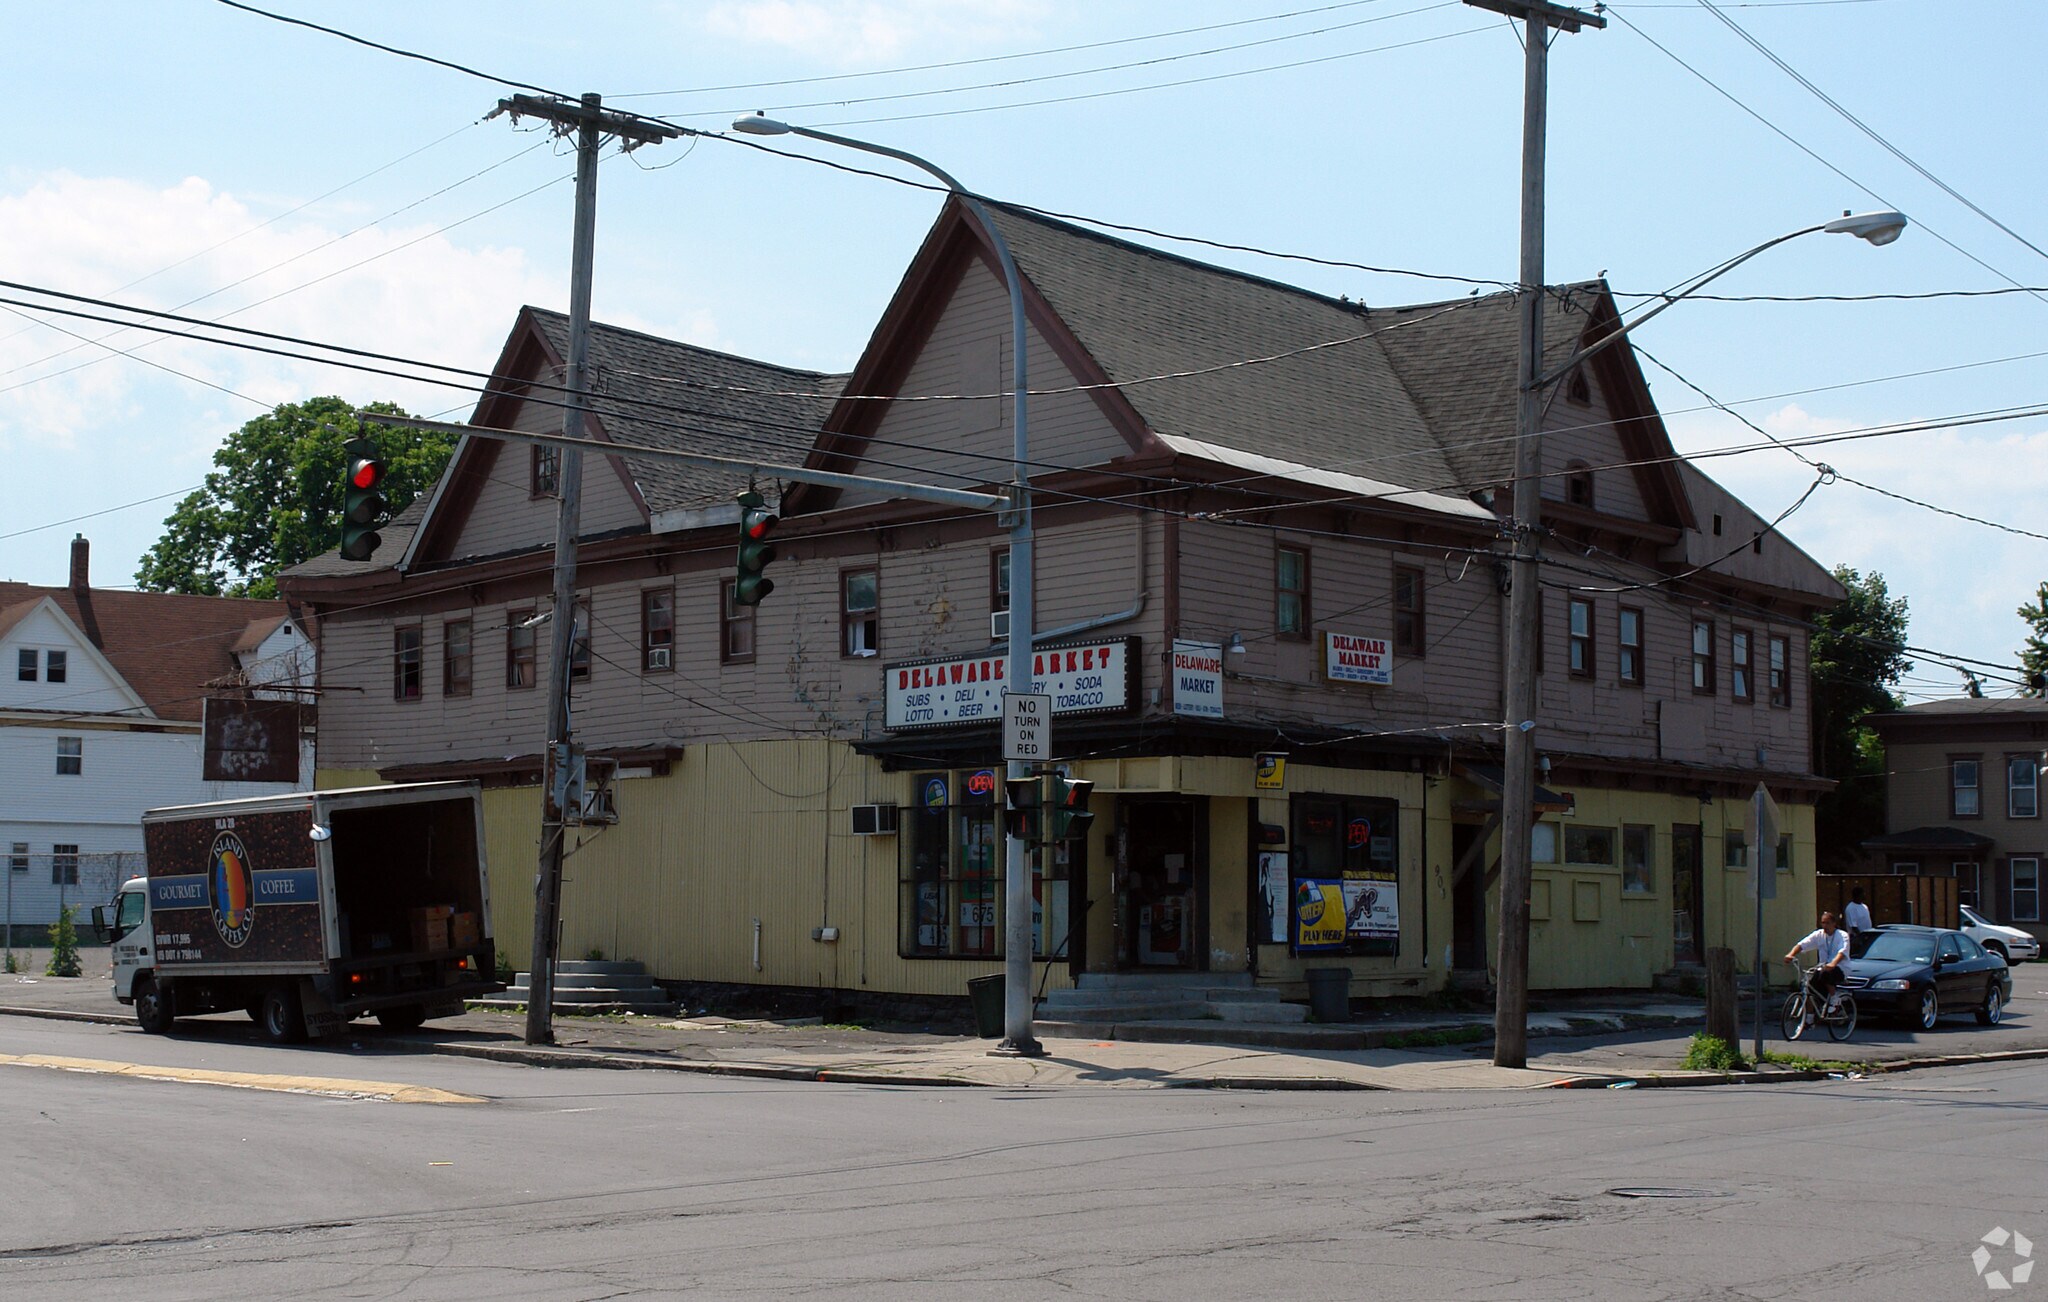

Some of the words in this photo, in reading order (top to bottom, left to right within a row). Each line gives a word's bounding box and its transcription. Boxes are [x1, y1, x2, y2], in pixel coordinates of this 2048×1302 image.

[1333, 636, 1386, 654] DELAWARE
[899, 660, 1004, 690] DELAWARE
[1034, 648, 1110, 676] ARKET
[1175, 654, 1220, 674] DELAWARE
[1339, 652, 1380, 670] MARKET
[906, 694, 930, 707] SUBS
[955, 688, 975, 702] DELI
[1075, 676, 1102, 690] SODA
[1180, 677, 1215, 694] MARKET
[905, 708, 934, 722] LOTTO
[958, 703, 983, 717] BEER
[1056, 692, 1104, 708] TOBACCO
[1019, 701, 1036, 713] NO
[1014, 716, 1040, 727] TURN
[1020, 730, 1034, 740] ON
[1017, 744, 1038, 754] RED
[969, 776, 994, 791] OPEN
[1348, 823, 1368, 843] PEN
[214, 838, 243, 860] ISLAND
[159, 884, 202, 900] GOURMET
[260, 879, 295, 894] COFFEE
[214, 909, 244, 944] COFFEE
[1304, 930, 1319, 942] PLAY
[1322, 930, 1342, 940] HERE
